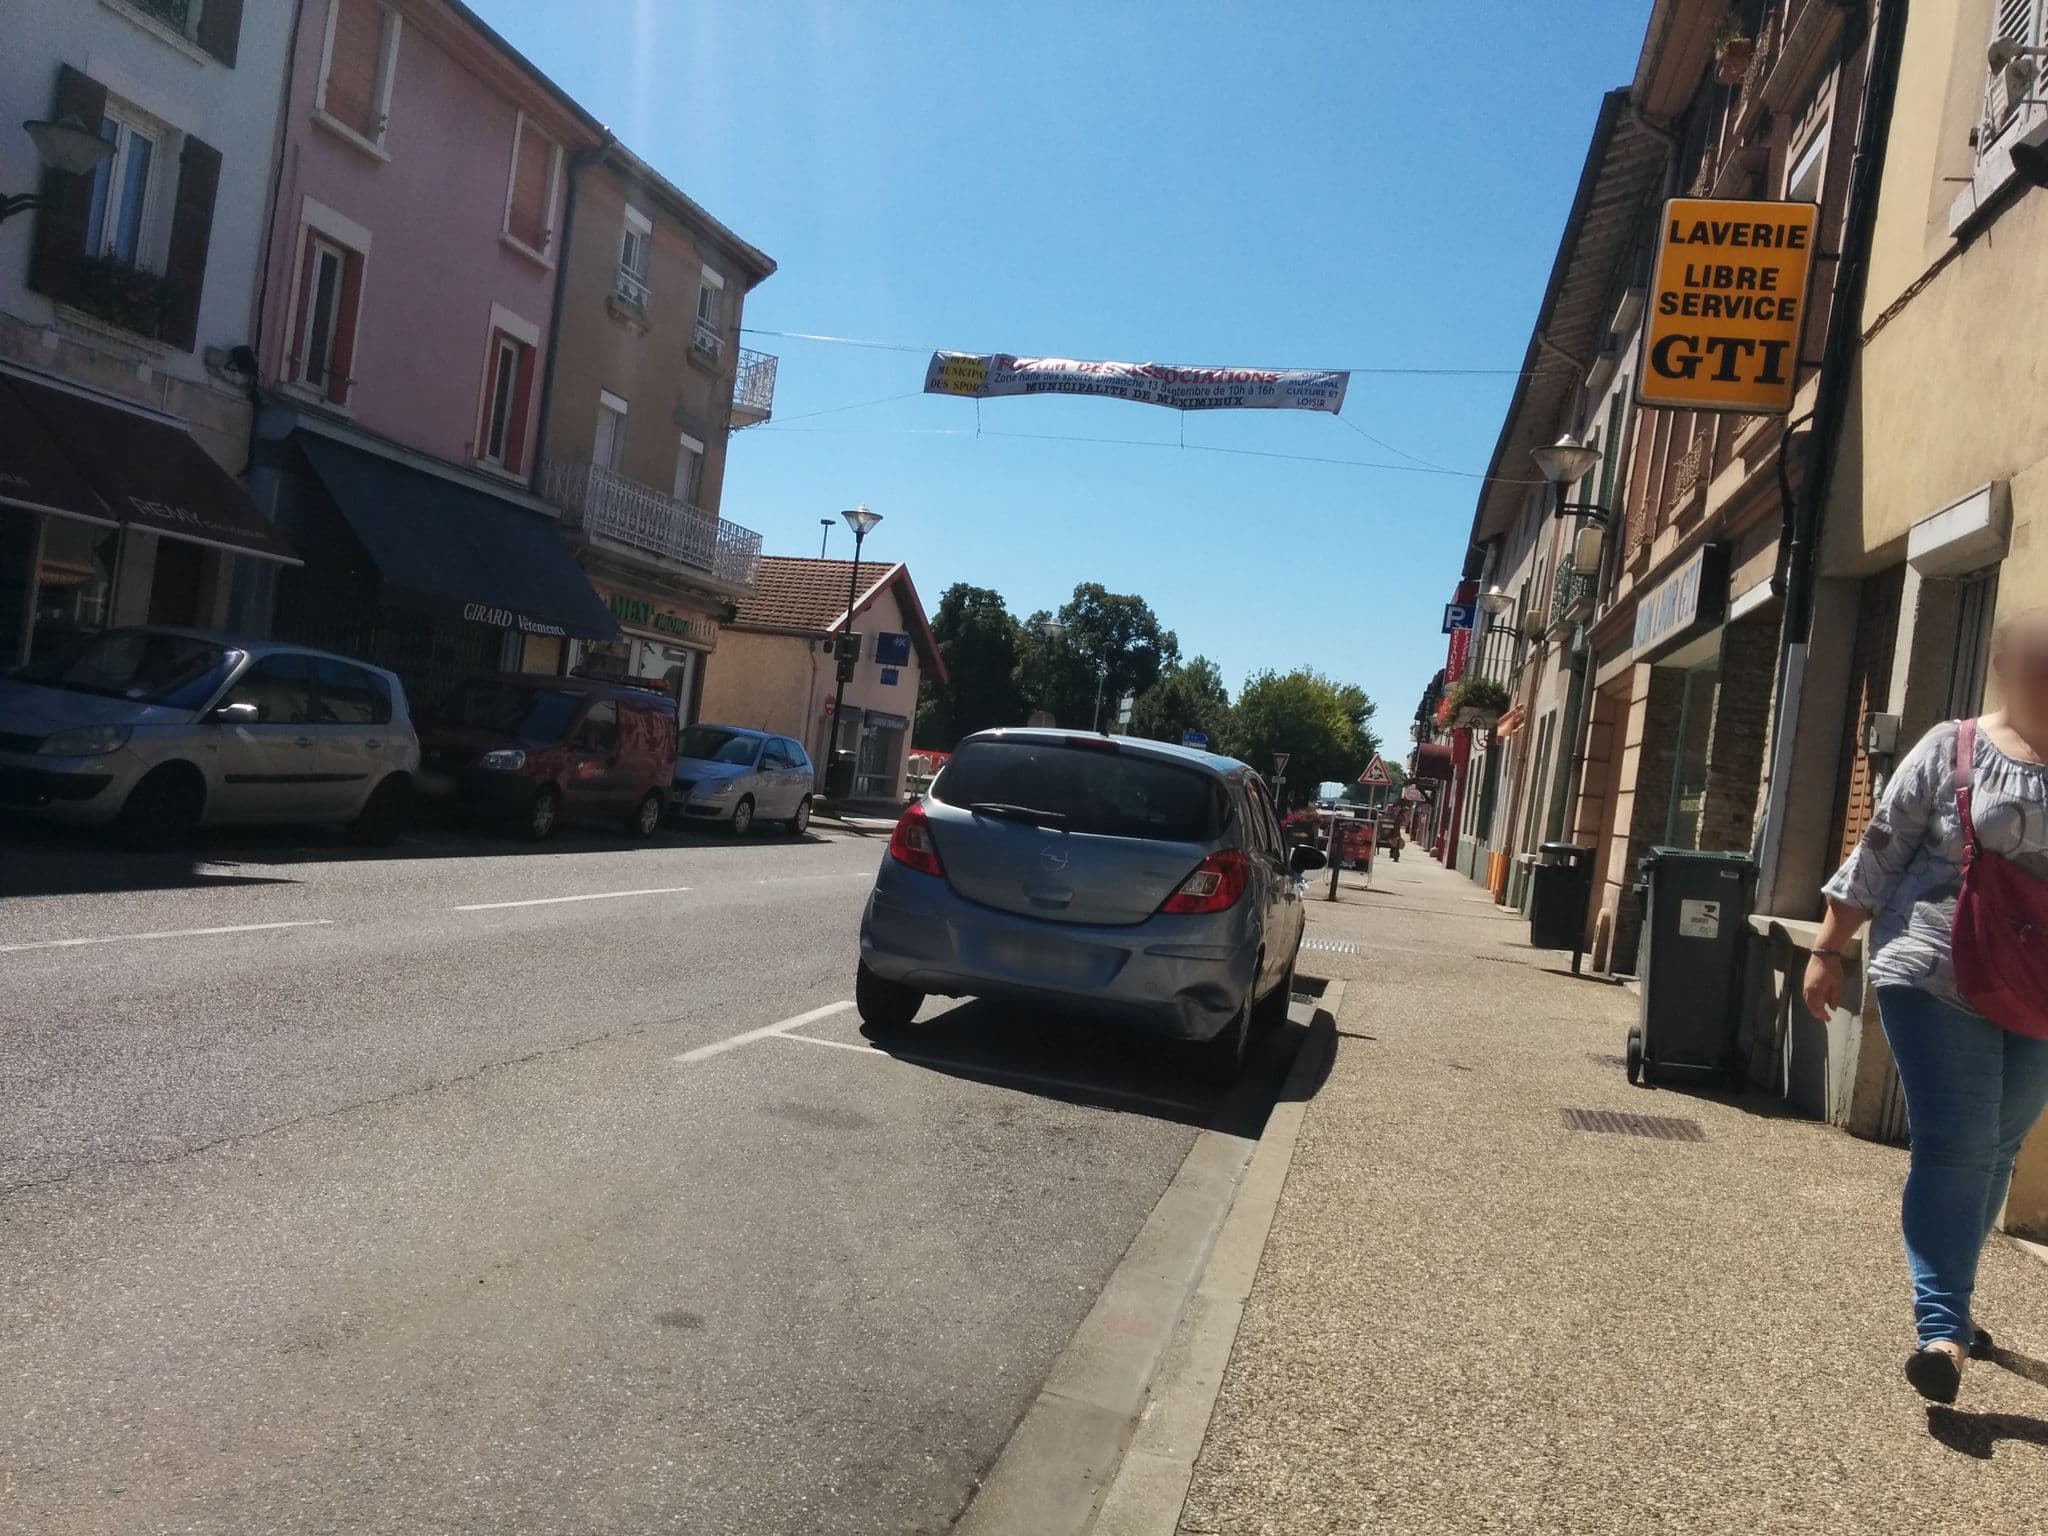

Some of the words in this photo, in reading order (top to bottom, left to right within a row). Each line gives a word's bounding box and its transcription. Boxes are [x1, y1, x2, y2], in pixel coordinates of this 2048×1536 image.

[1669, 219, 1808, 249] LAVERIE
[1684, 264, 1780, 291] LIBRE
[1658, 291, 1798, 322] SERVICE
[1651, 334, 1791, 385] GTI
[930, 378, 949, 389] DES
[993, 373, 1018, 384] Zone
[1043, 372, 1060, 381] des
[1062, 373, 1093, 384] sports
[1096, 375, 1144, 389] Dimanche
[1148, 380, 1159, 391] 13
[1213, 385, 1226, 396] de
[1230, 385, 1245, 396] 10h
[1258, 385, 1275, 396] 16h
[1132, 389, 1152, 400] DE
[1286, 387, 1327, 397] CULTURE
[1328, 390, 1340, 399] ET
[1288, 380, 1339, 389] MUNICIPAL
[1297, 397, 1326, 408] LOISIR
[463, 602, 513, 627] GIRARD
[517, 614, 566, 636] Vêtements
